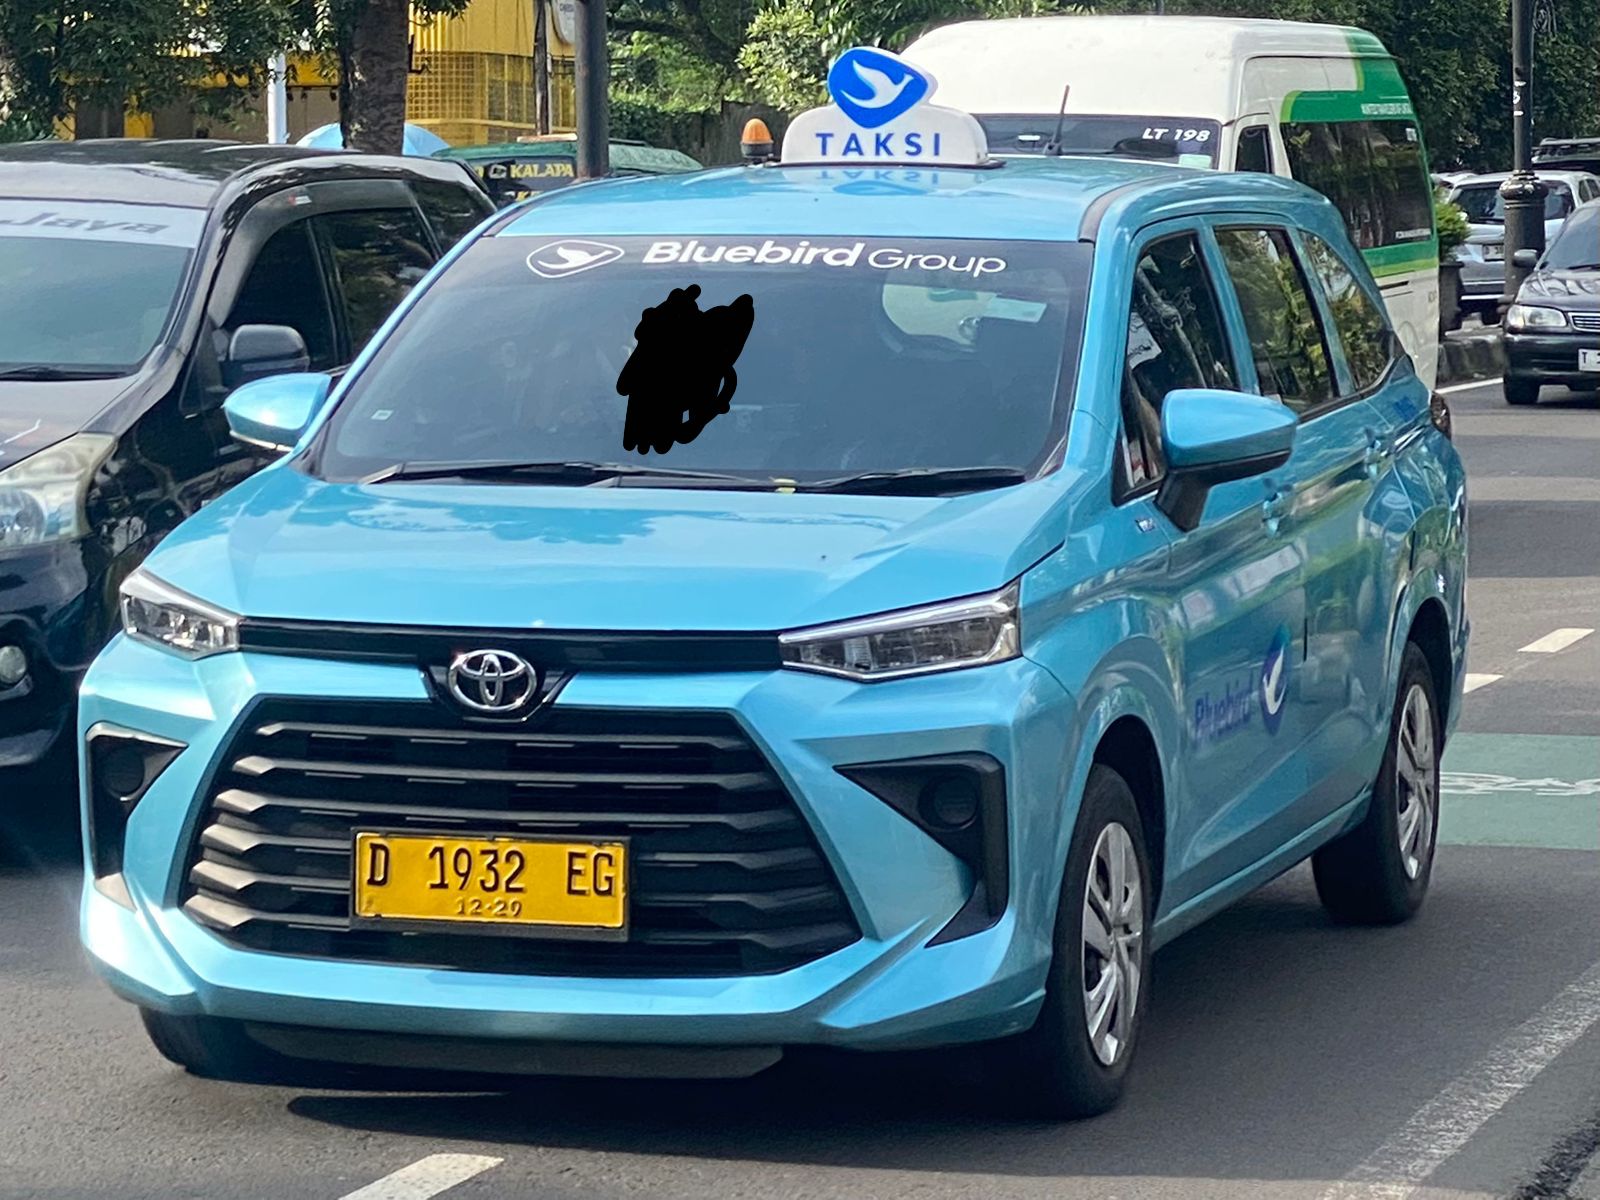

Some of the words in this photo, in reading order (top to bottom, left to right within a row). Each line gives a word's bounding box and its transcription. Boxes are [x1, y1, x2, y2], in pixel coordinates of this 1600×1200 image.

[815, 133, 940, 156] TAKSI
[1142, 128, 1169, 140] LT
[1174, 129, 1210, 142] 198
[510, 163, 574, 178] KALAPA
[642, 240, 865, 267] Bluebird
[868, 248, 1007, 278] Group
[1582, 351, 1588, 364] T
[367, 843, 390, 886] D
[428, 846, 526, 892] 1932
[567, 851, 615, 896] EG
